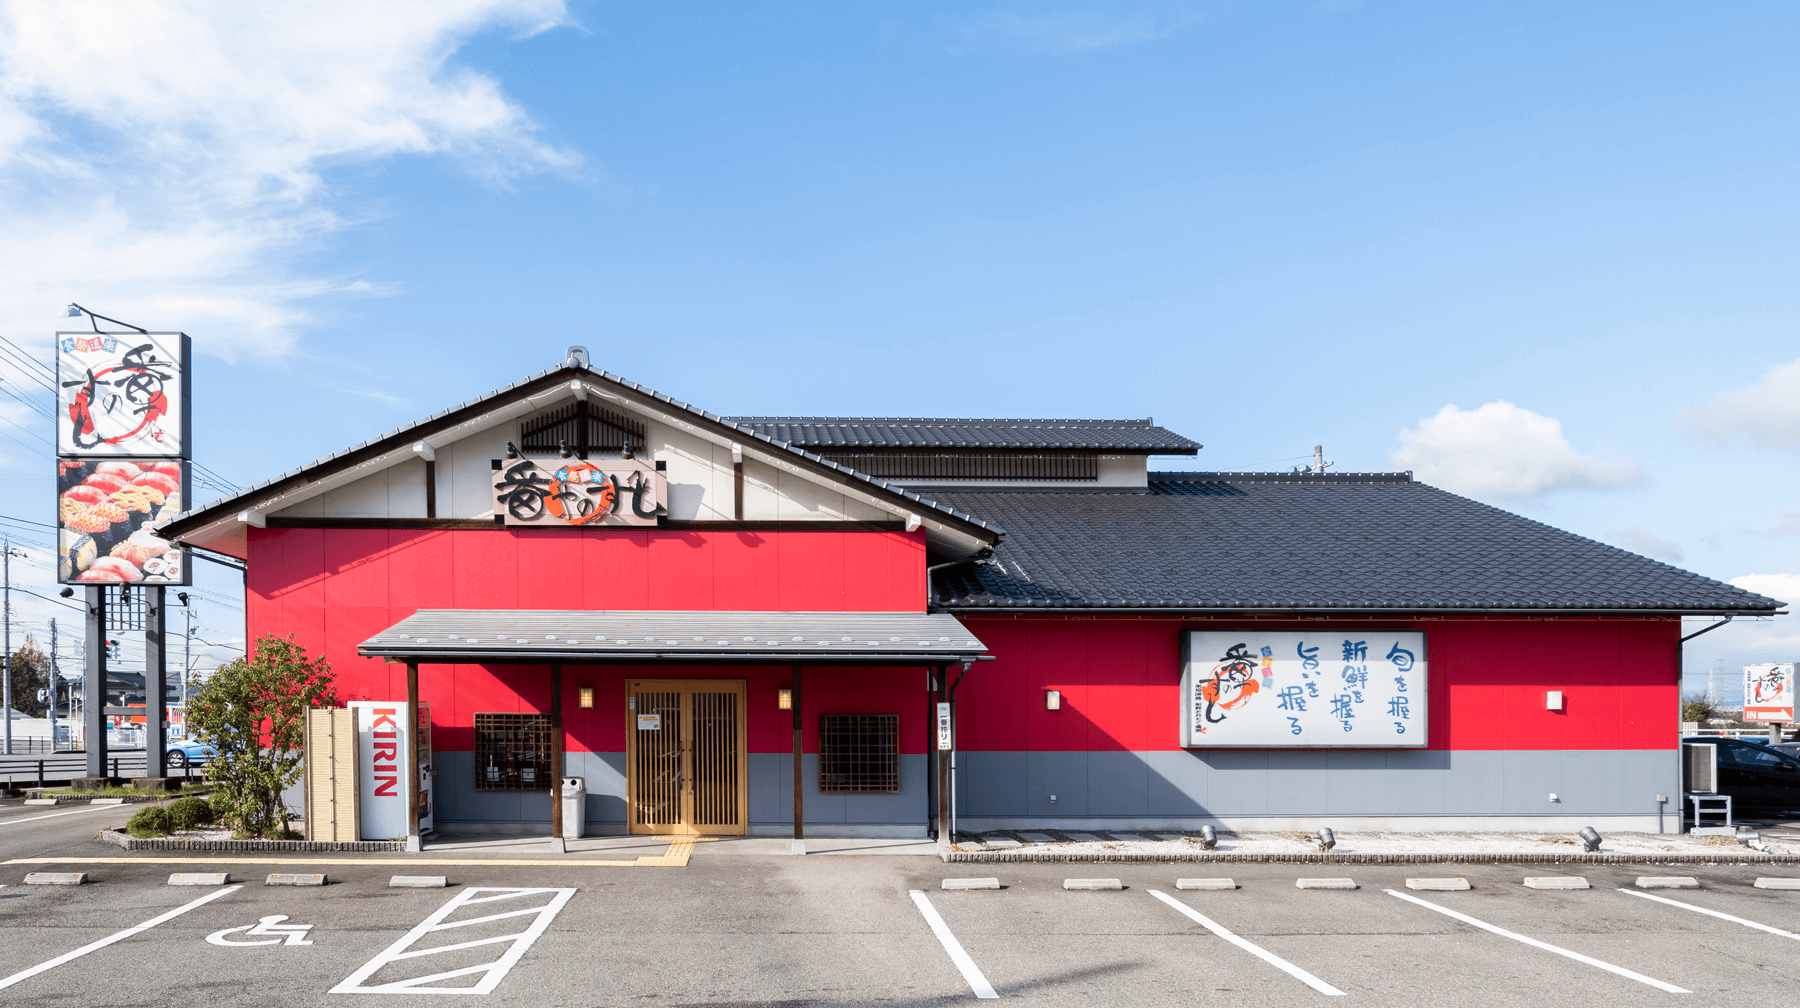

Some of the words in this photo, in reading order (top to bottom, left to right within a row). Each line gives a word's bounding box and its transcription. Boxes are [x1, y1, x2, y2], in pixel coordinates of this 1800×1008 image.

[1277, 641, 1321, 735] 旨いを握る
[1330, 640, 1368, 732] 新鮮を握る
[1386, 641, 1415, 734] 旬を握る
[1746, 711, 1757, 720] IN
[373, 708, 397, 797] KIRIN
